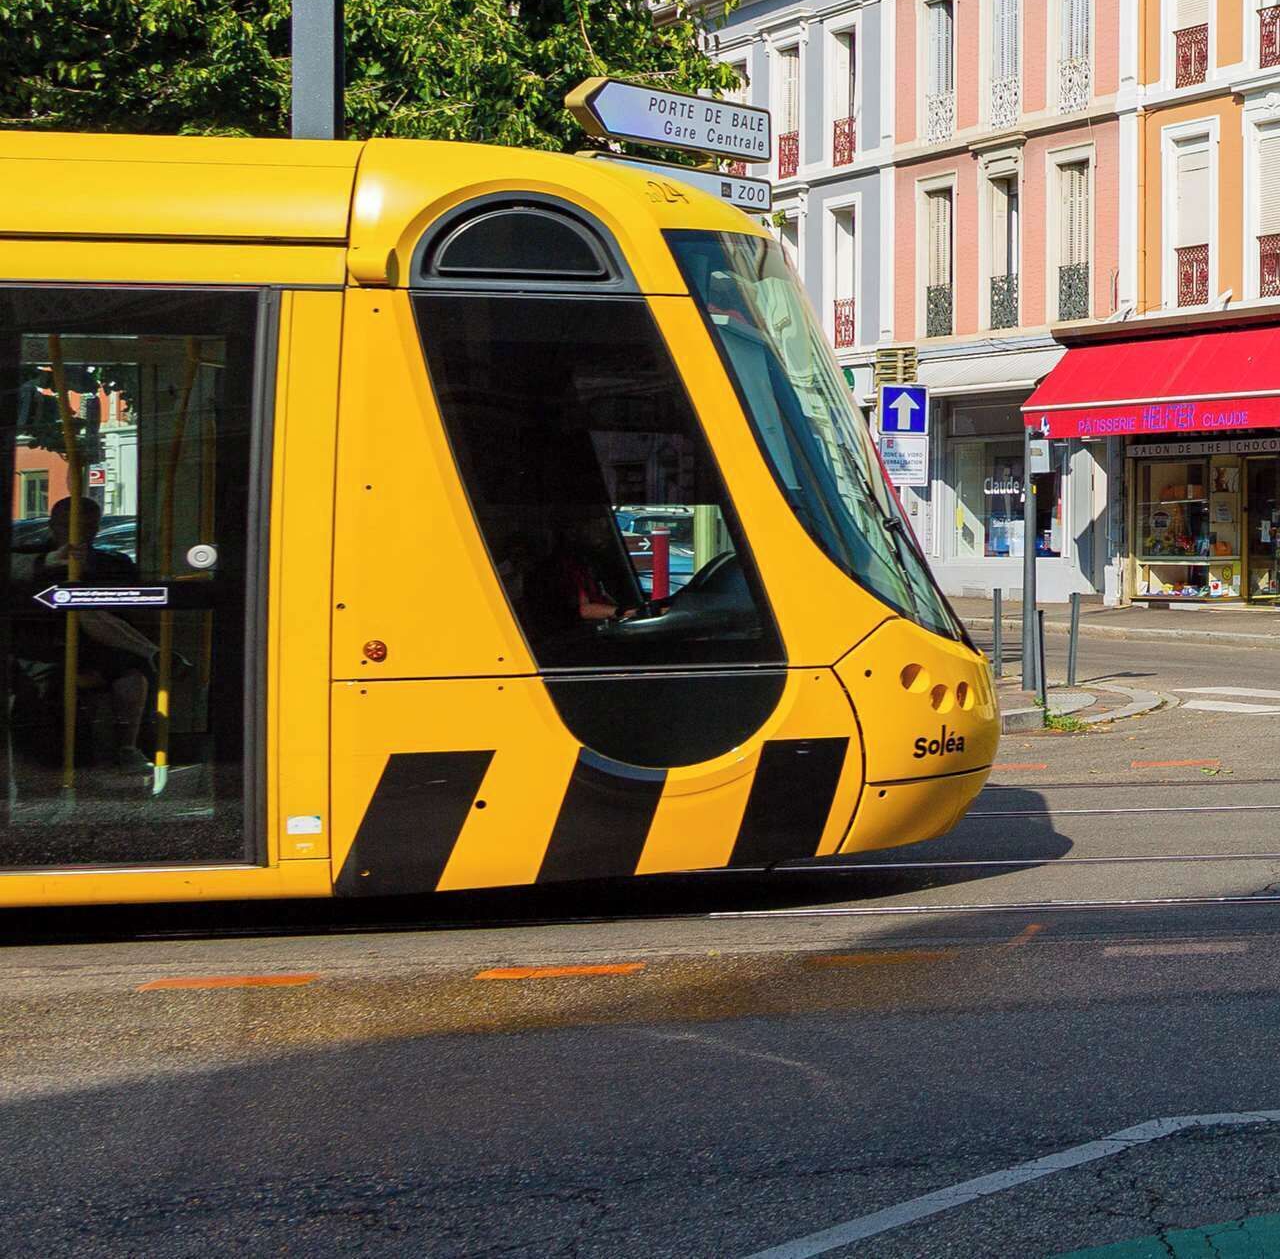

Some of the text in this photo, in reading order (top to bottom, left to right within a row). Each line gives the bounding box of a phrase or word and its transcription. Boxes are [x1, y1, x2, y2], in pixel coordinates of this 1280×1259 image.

[648, 96, 765, 133] PORTE DE BALE
[663, 120, 765, 152] Gare Centrale
[738, 185, 766, 203] ZOO
[1141, 403, 1196, 430] HELFTER
[1201, 411, 1249, 427] CLAUDE
[1134, 444, 1171, 456] SALON
[1178, 443, 1192, 455] DE
[984, 476, 1020, 495] Claude
[912, 724, 965, 759] Soléa
